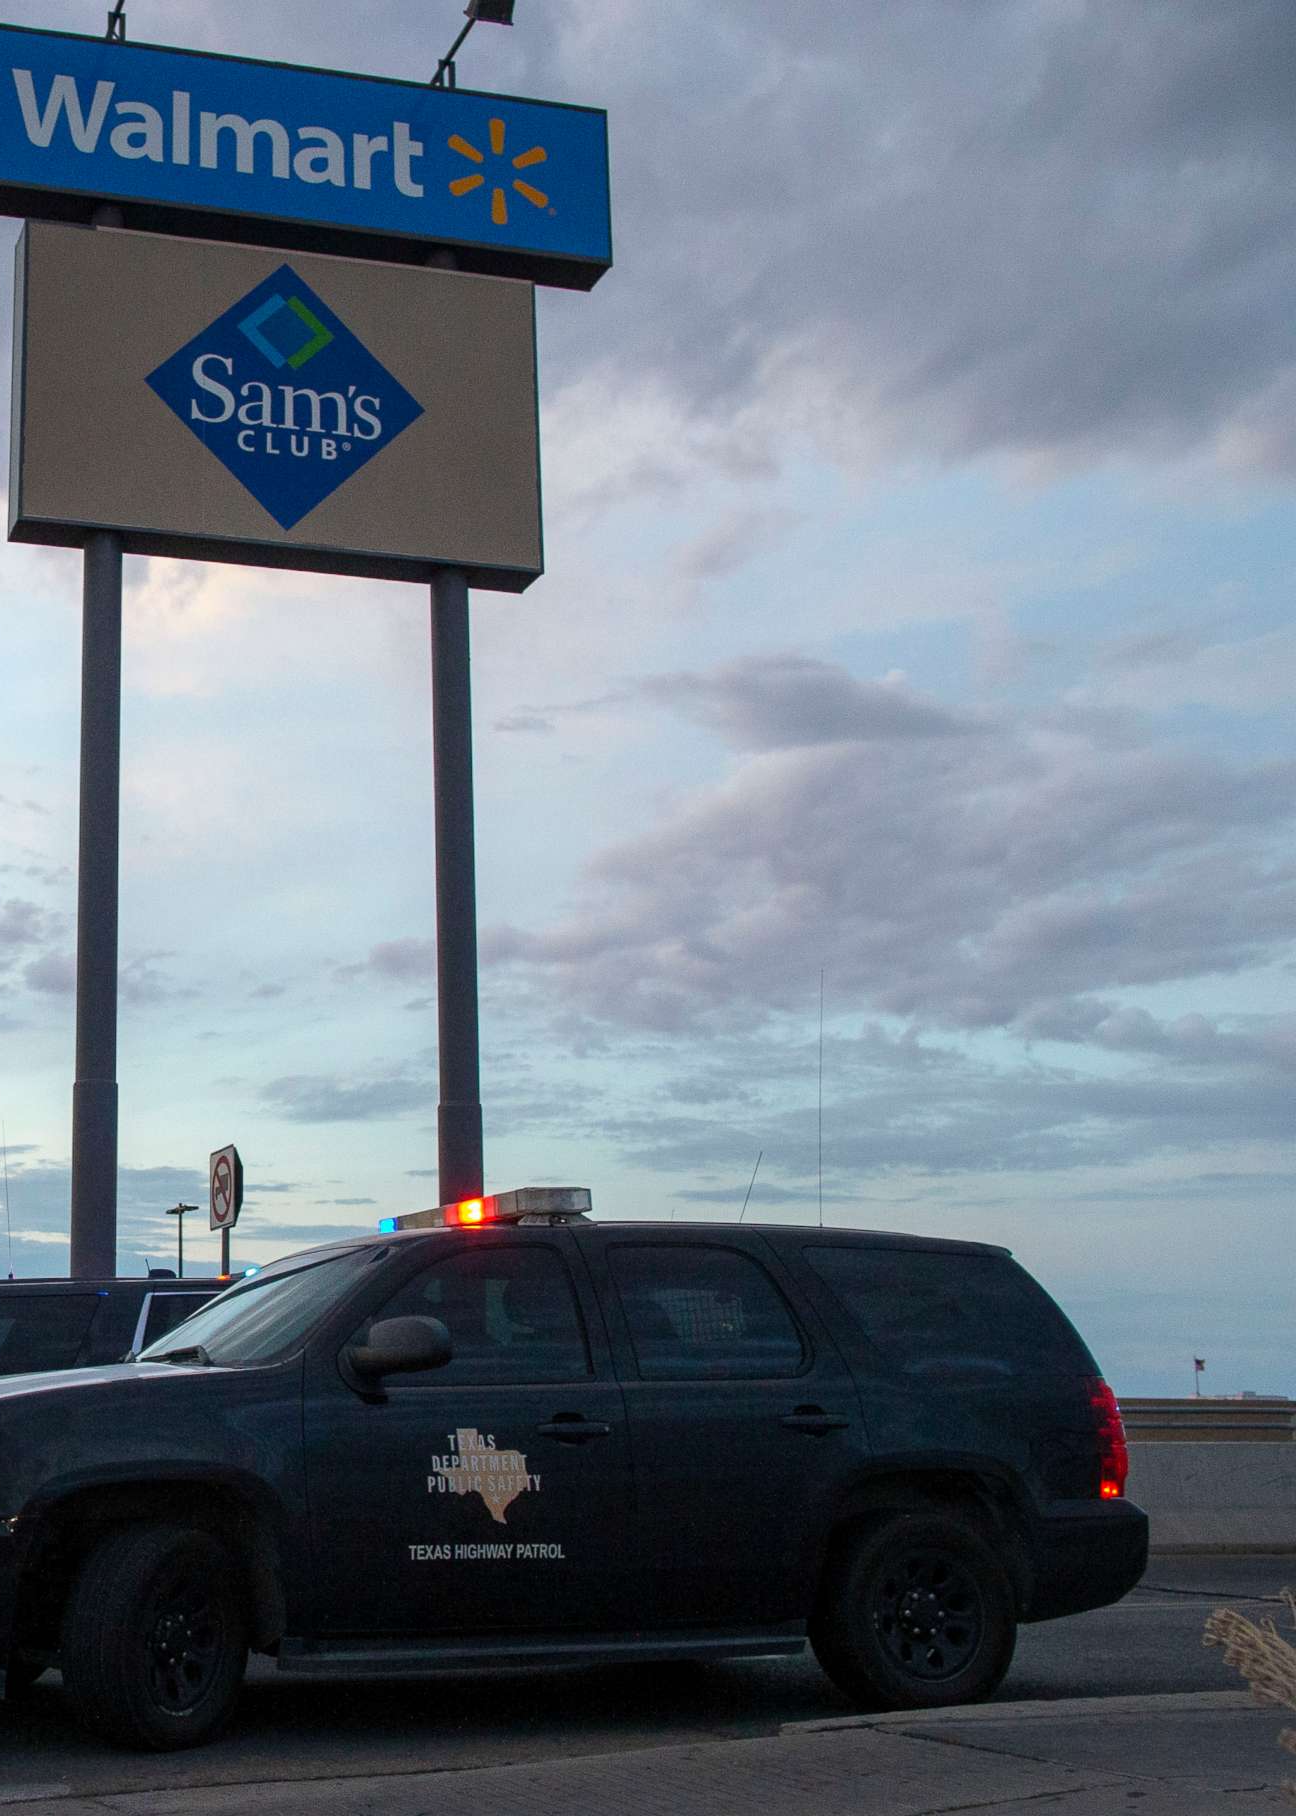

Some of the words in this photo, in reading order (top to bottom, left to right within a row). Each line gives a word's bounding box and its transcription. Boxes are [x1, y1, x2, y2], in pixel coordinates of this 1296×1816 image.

[11, 68, 425, 198] Walmart
[190, 353, 383, 441] Sam's
[447, 1434, 496, 1451] TEXAS
[432, 1454, 528, 1473] DEPARTMENT
[427, 1475, 482, 1493] PUBLIC
[487, 1474, 542, 1492] SAFETY
[408, 1544, 452, 1561] TEXAS
[454, 1544, 514, 1560] HIGHWAY
[516, 1543, 566, 1560] PATROL
